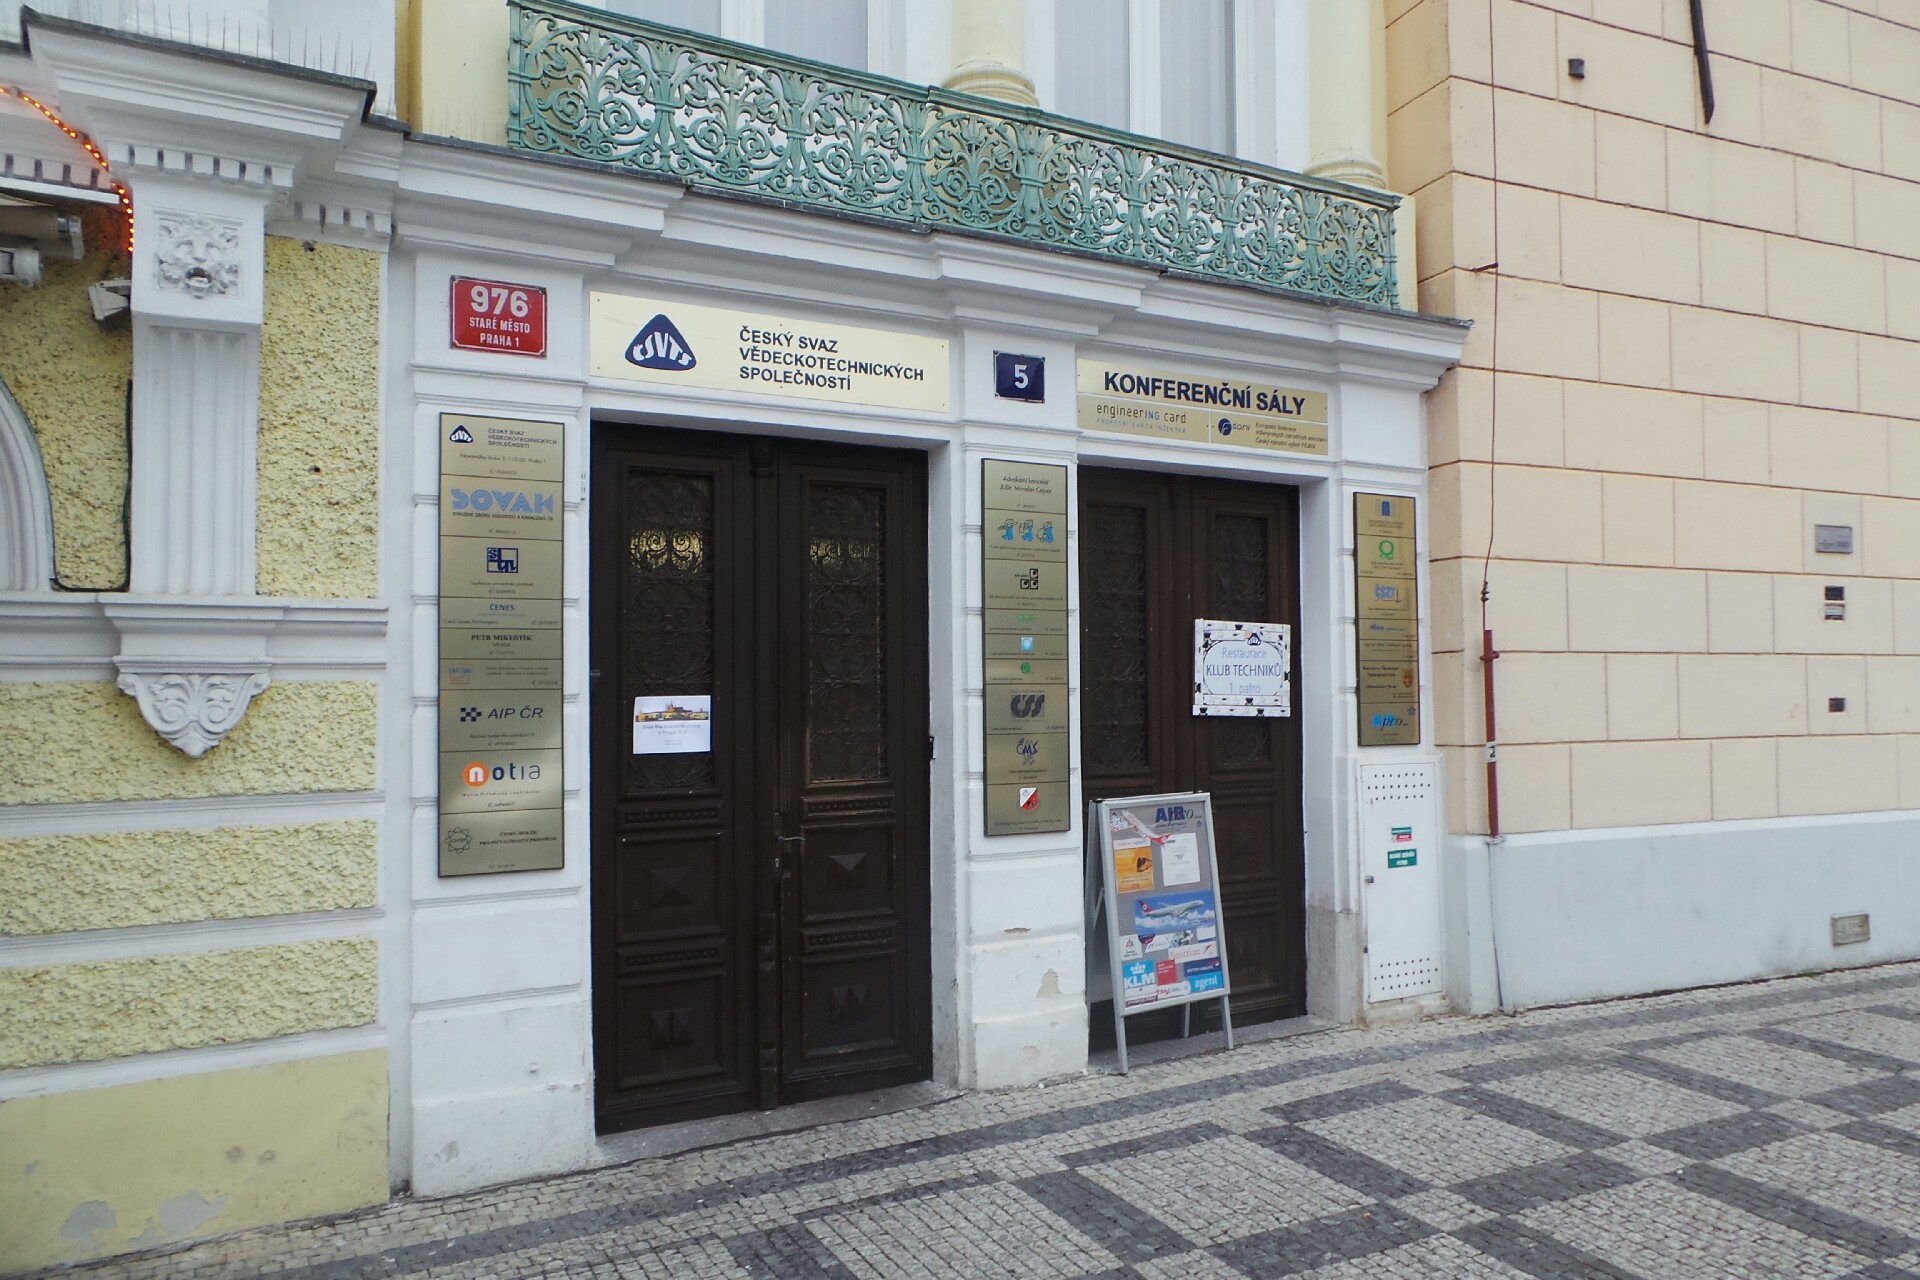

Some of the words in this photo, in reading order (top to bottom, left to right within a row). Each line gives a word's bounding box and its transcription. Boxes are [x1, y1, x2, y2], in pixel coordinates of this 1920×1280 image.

[471, 286, 528, 317] 976
[470, 317, 497, 329] STARÉ
[500, 319, 530, 333] MĚSTO
[480, 333, 511, 346] PRAHA
[515, 337, 519, 347] 1
[740, 326, 793, 347] ČESKÝ
[799, 337, 838, 353] SVAZ
[740, 346, 923, 380] VĚDECKOTECHNICKÝCH
[740, 366, 850, 390] SPOLEČNOSTÍ
[1015, 365, 1028, 388] 5
[1105, 372, 1251, 408] KONFERENČNÍ
[1256, 390, 1305, 415] SÁLY
[1097, 405, 1160, 420] engineerING
[1164, 412, 1186, 423] card
[451, 488, 553, 513] SOVAK
[1222, 647, 1267, 659] Restaurace
[1207, 664, 1231, 676] KLUB
[1233, 663, 1281, 676] TECHNIKŮ
[1240, 683, 1261, 695] patro
[488, 708, 516, 719] AIP
[520, 705, 544, 719] ČR
[1124, 972, 1155, 989] KLM
[1194, 975, 1218, 989] agent
